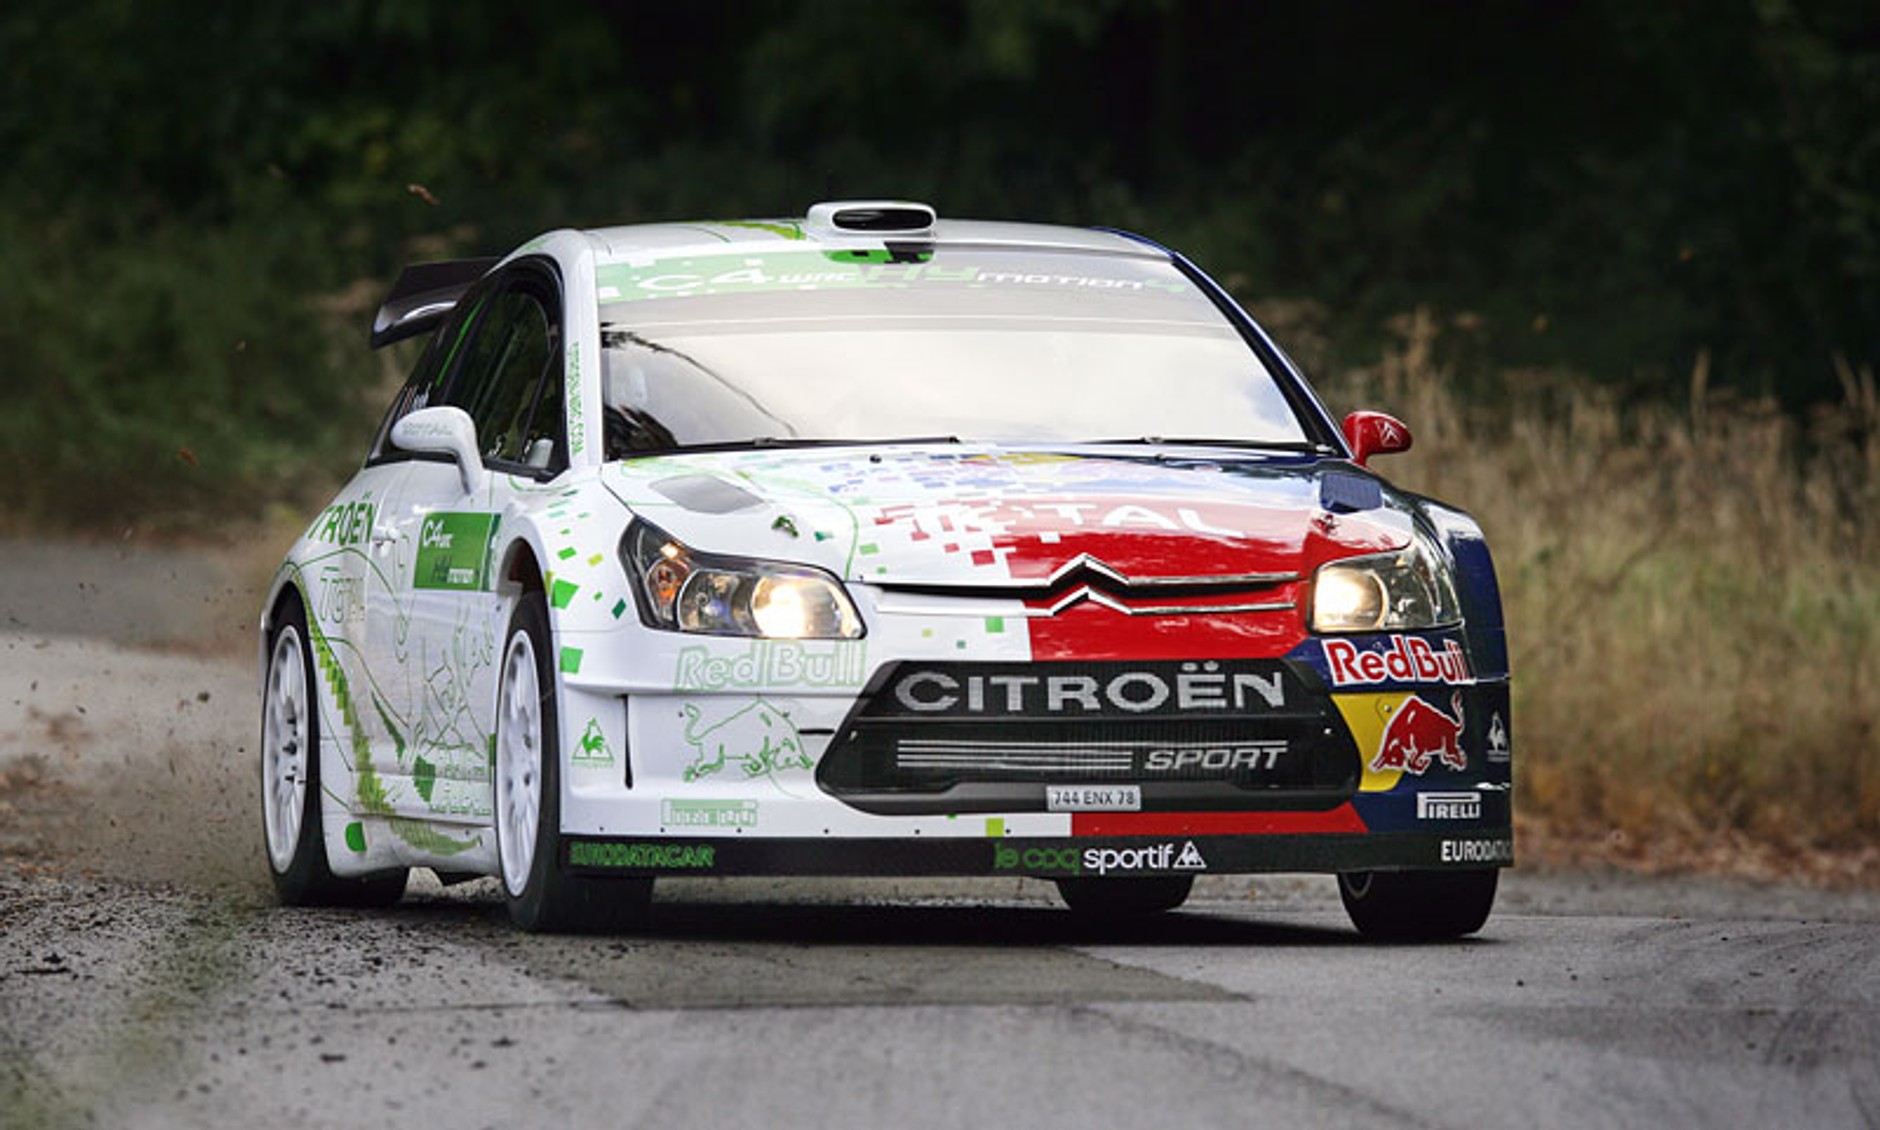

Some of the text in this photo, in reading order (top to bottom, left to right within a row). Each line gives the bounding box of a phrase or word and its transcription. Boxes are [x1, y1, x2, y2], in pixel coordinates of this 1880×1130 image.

[674, 640, 866, 690] Red Bull
[1322, 635, 1473, 686] Red Bull
[895, 661, 1286, 712] CITROËN
[1144, 746, 1289, 770] SPORT
[1054, 789, 1135, 806] 744 ENX 78
[1417, 792, 1481, 819] PIRELLI
[994, 842, 1174, 876] le coq sportif
